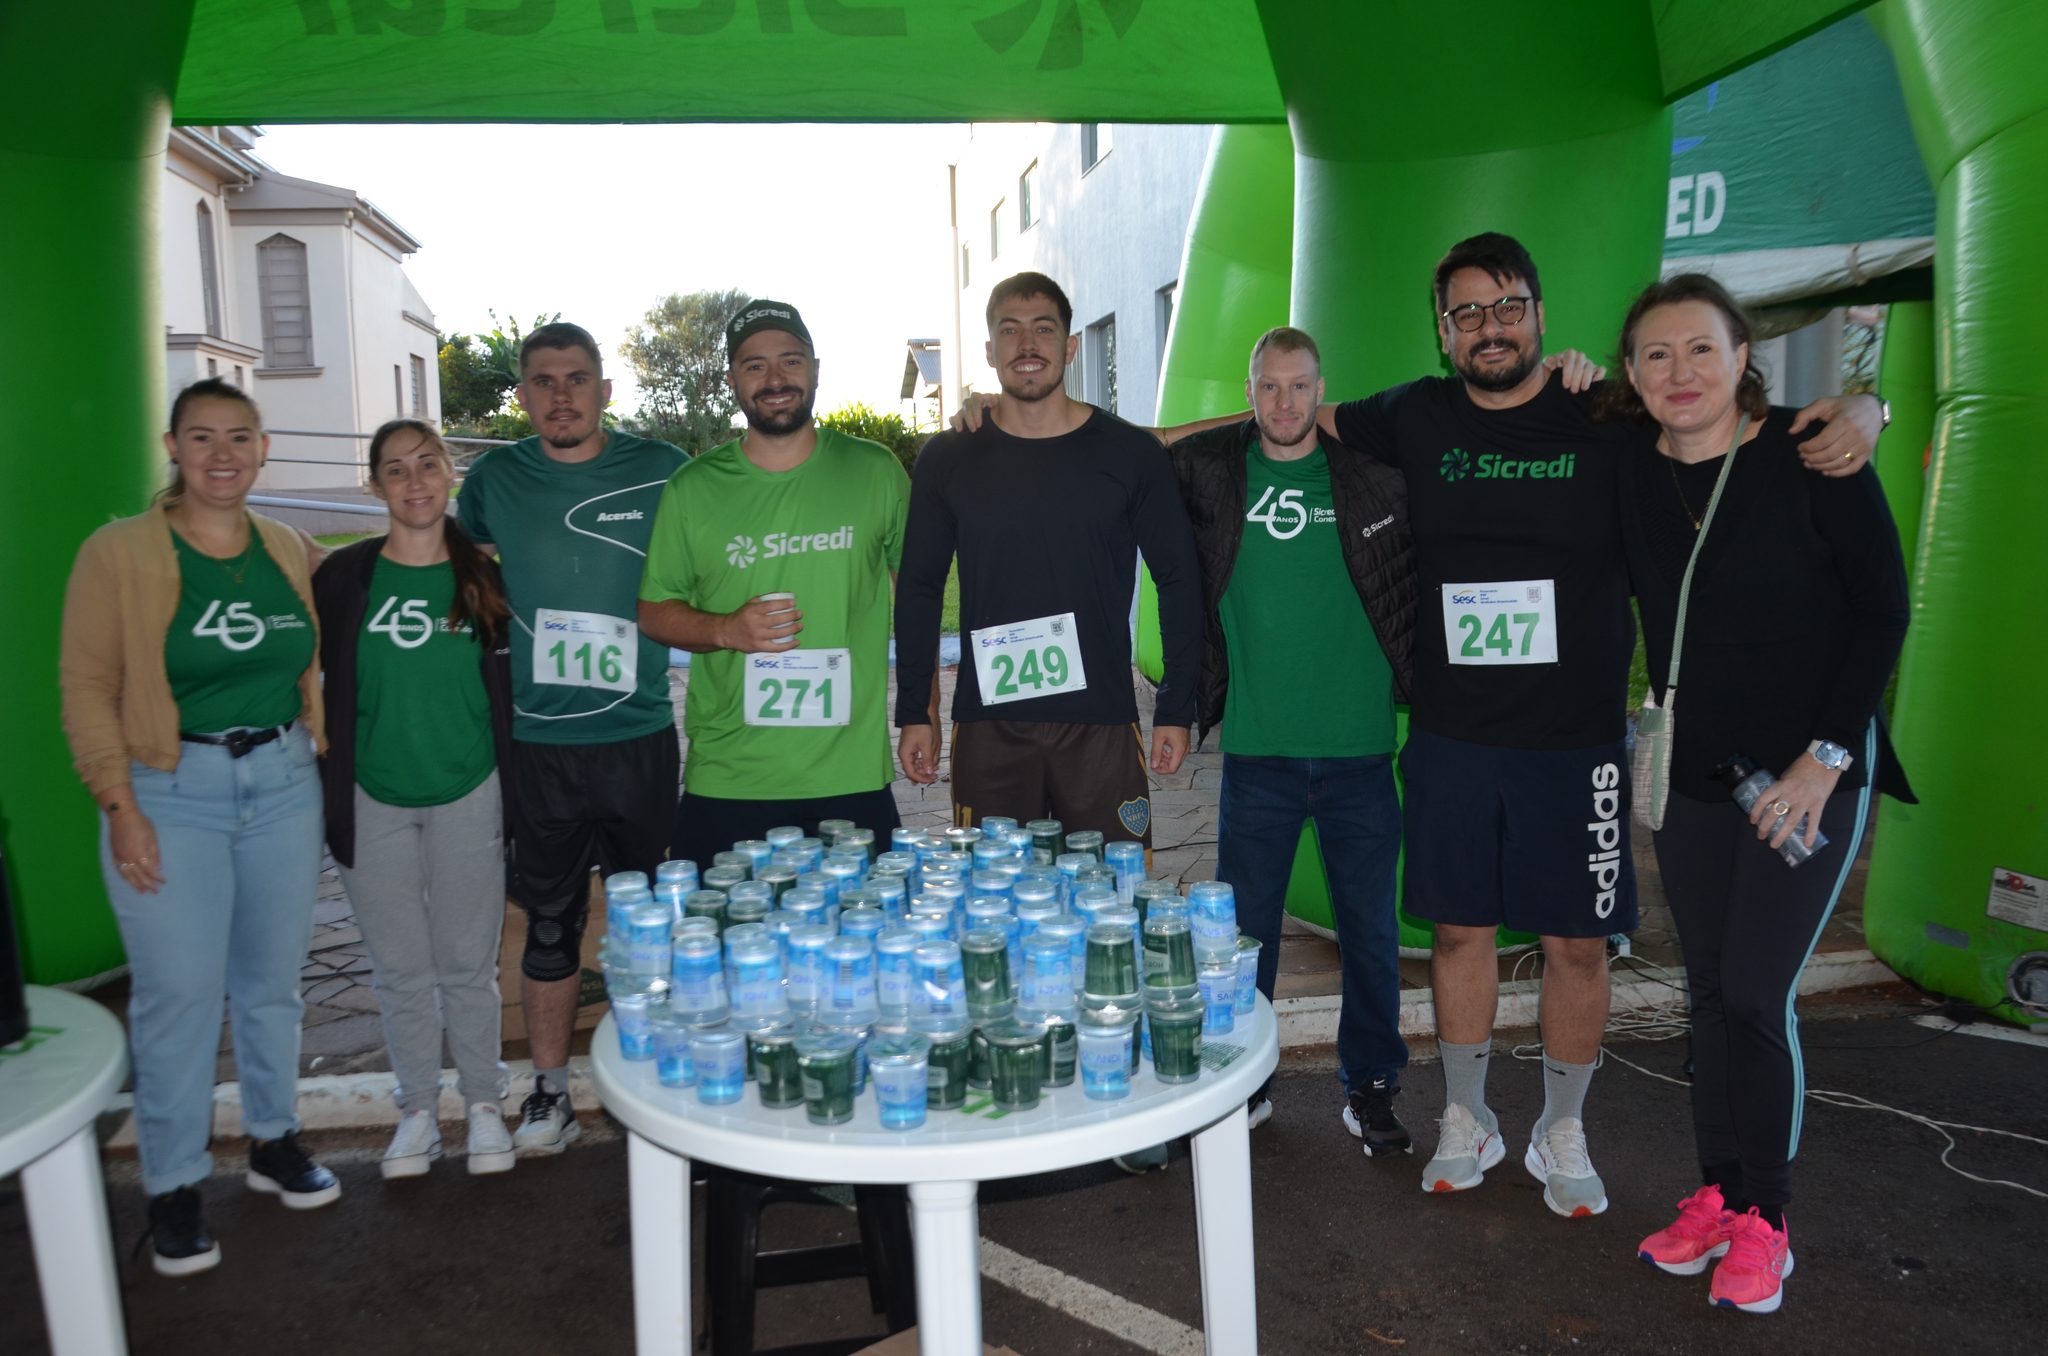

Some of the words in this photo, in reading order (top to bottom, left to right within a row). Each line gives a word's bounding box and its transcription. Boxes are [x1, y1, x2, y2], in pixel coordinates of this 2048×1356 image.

[746, 308, 791, 323] Sicredi
[1474, 453, 1576, 479] Sicredi
[596, 509, 645, 522] Acersic
[1246, 485, 1308, 540] 45
[1370, 513, 1395, 533] Sicredi
[763, 525, 854, 559] Sicredi
[191, 599, 266, 652] 45
[366, 596, 433, 649] 45
[1458, 612, 1540, 657] 247
[548, 639, 623, 684] 116
[991, 645, 1069, 697] 249
[758, 677, 832, 719] 271
[1587, 762, 1621, 919] adidas
